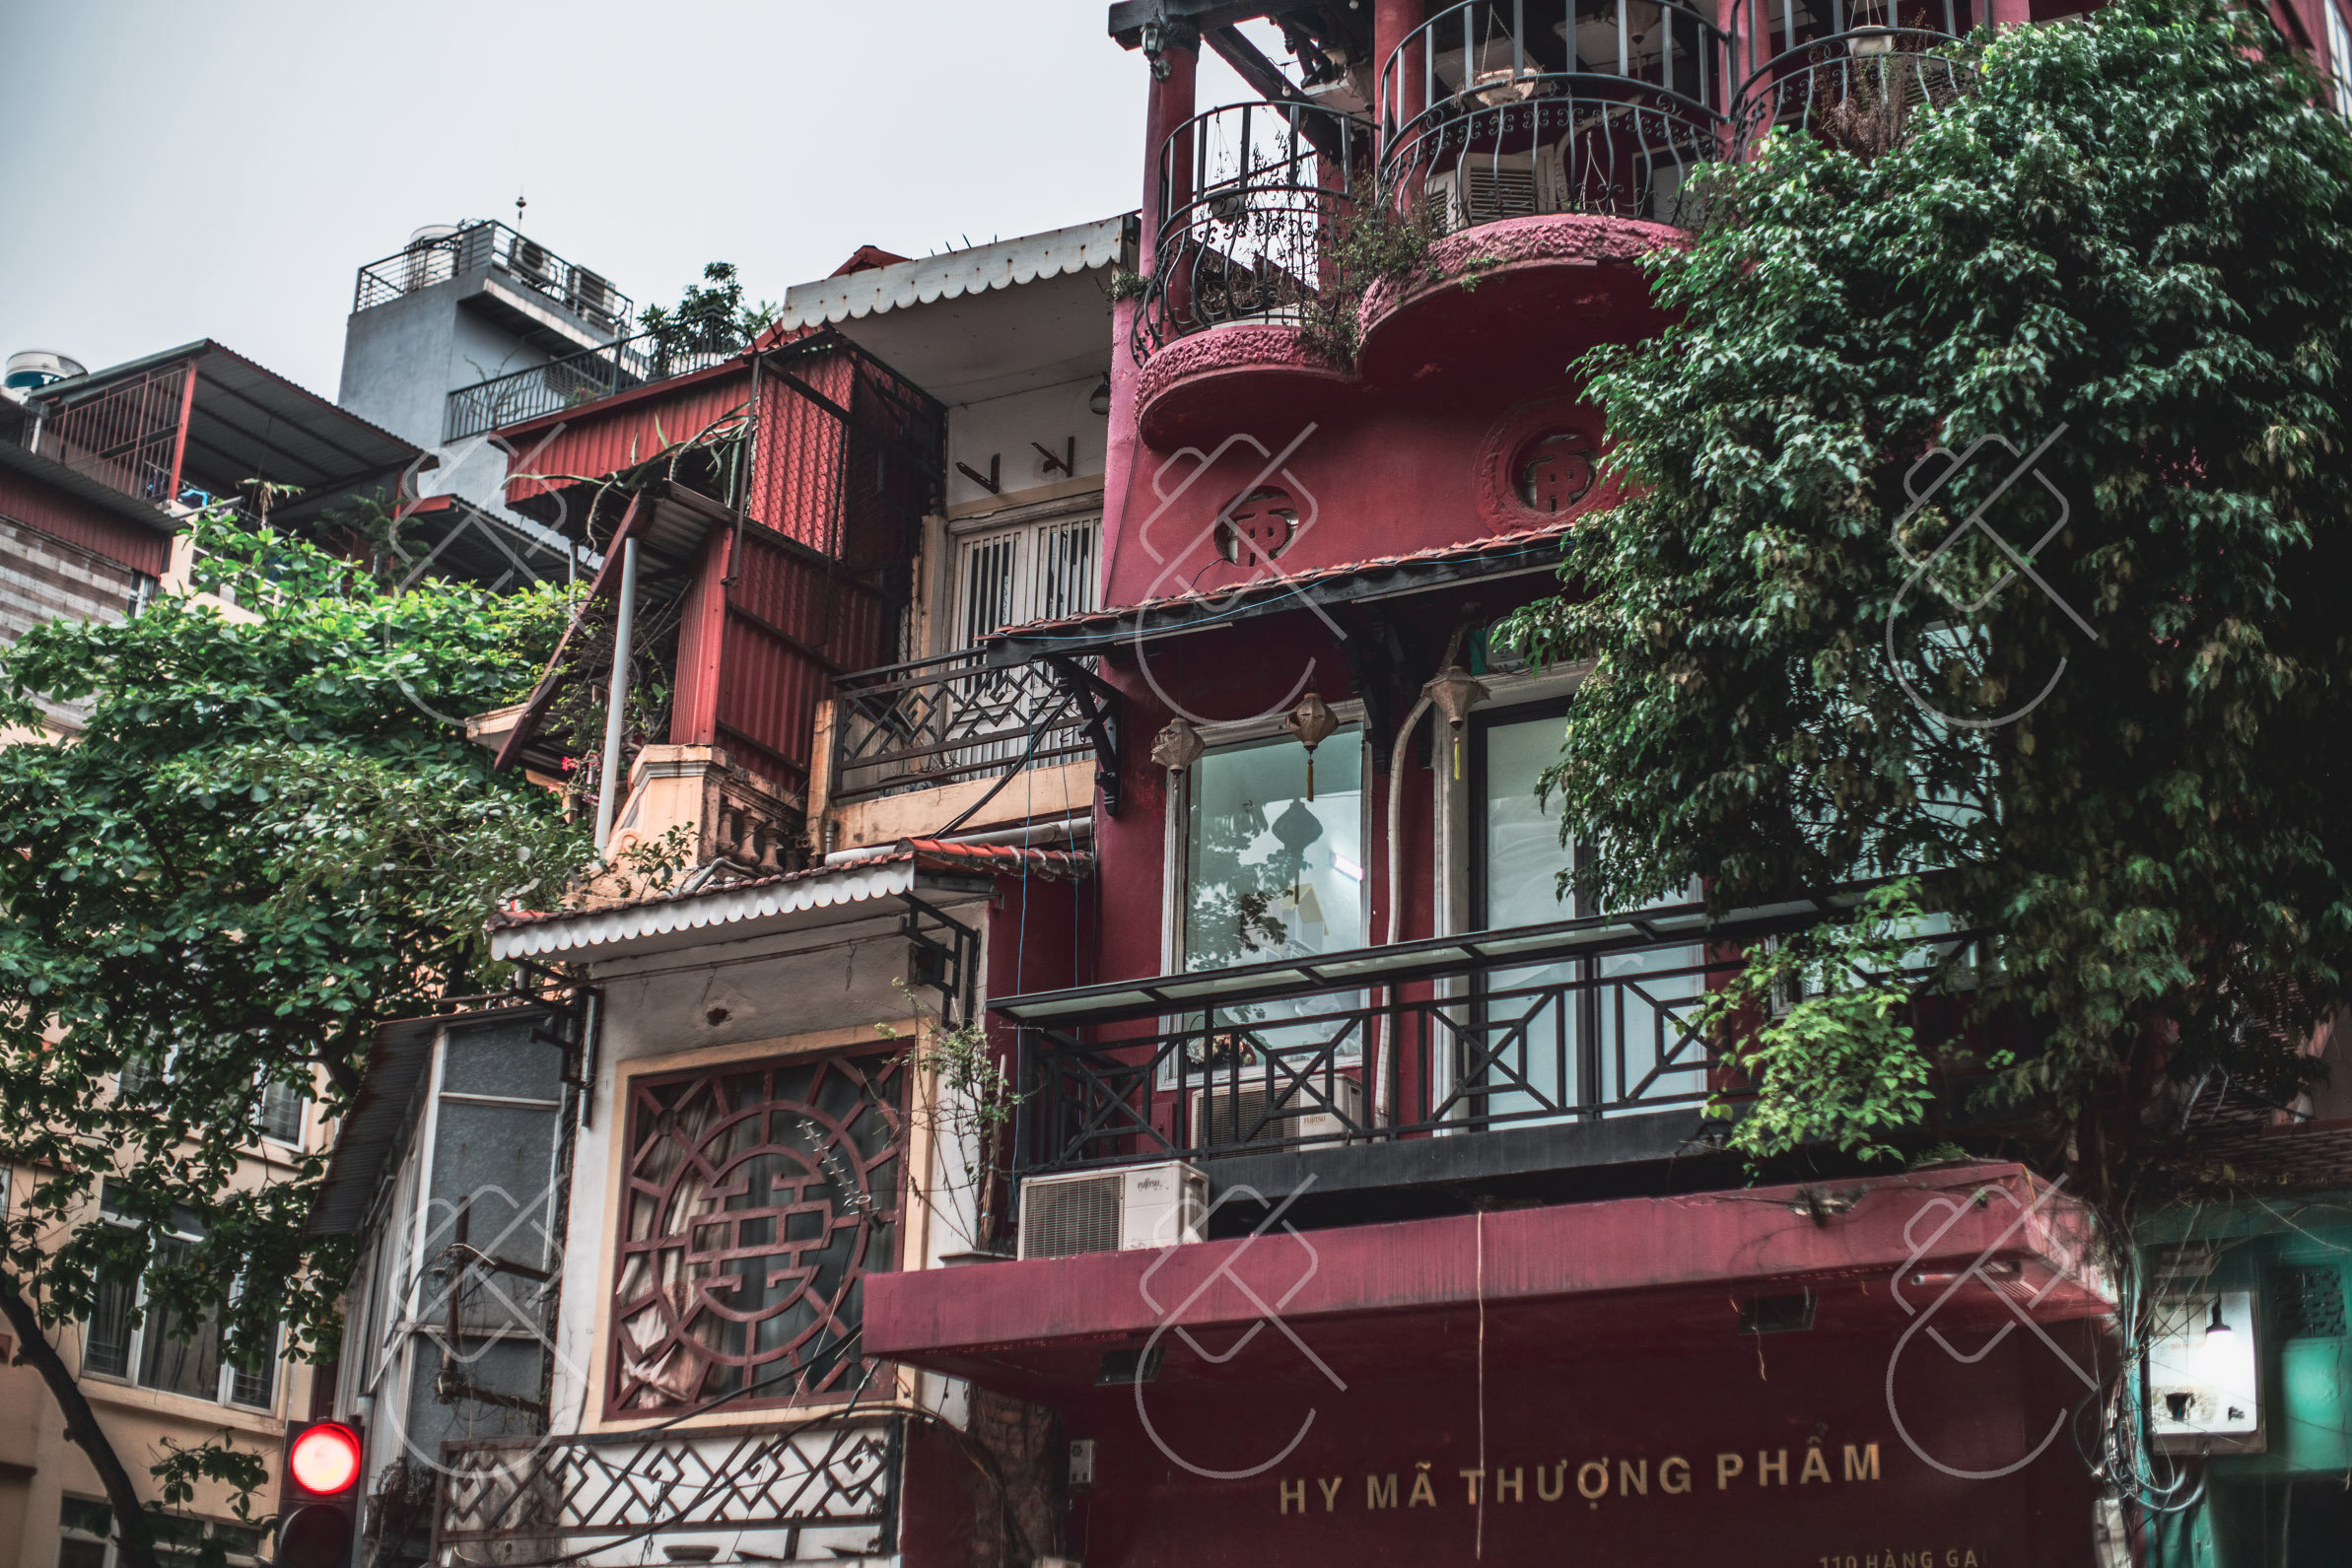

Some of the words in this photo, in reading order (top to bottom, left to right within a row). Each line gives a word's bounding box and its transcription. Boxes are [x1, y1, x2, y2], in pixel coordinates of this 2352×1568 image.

[1137, 1178, 1160, 1191] FUJITSU
[1280, 1475, 1343, 1515] HY
[1366, 1460, 1437, 1510] MÃ
[1459, 1456, 1693, 1510] THƯỢNG
[1715, 1421, 1882, 1490] PHẨM
[1819, 1555, 1857, 1568] 110
[1865, 1548, 1933, 1568] HÀNG
